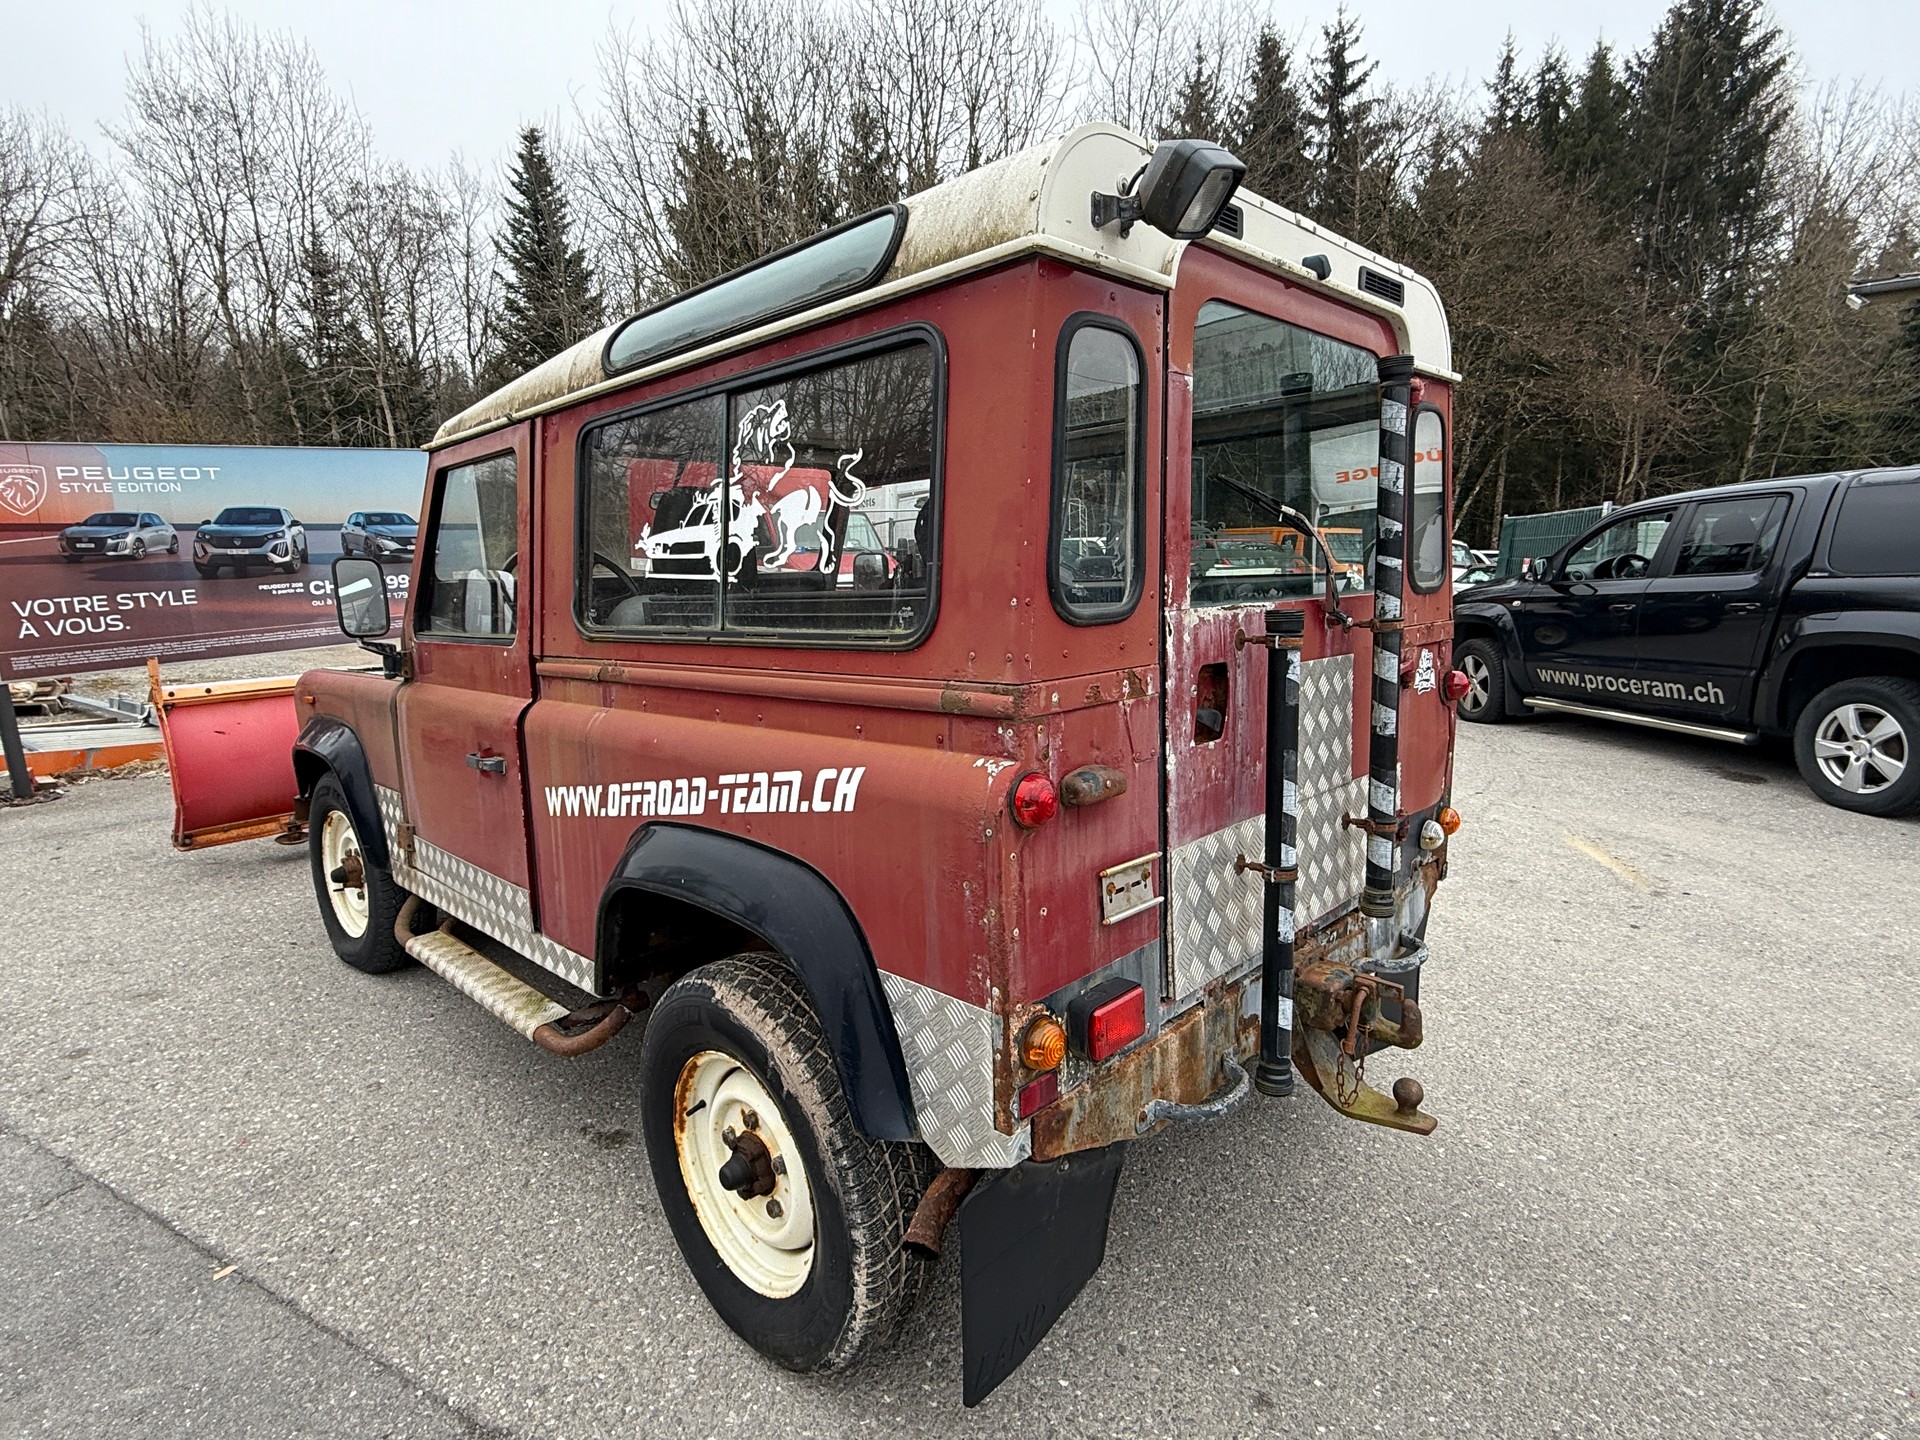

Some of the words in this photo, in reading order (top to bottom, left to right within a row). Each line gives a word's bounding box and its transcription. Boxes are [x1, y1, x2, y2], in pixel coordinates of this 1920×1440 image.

[55, 466, 221, 480] PEUGEOT
[60, 482, 113, 493] STYLE
[118, 482, 182, 493] EDITION
[11, 595, 110, 617] VOTRE
[116, 589, 198, 610] STYLE
[18, 619, 40, 639] À
[44, 615, 131, 636] VOUS.
[1536, 668, 1725, 704] www.proceram.ch
[545, 767, 866, 817] WWW.OFFROAD-TEAM.CH
